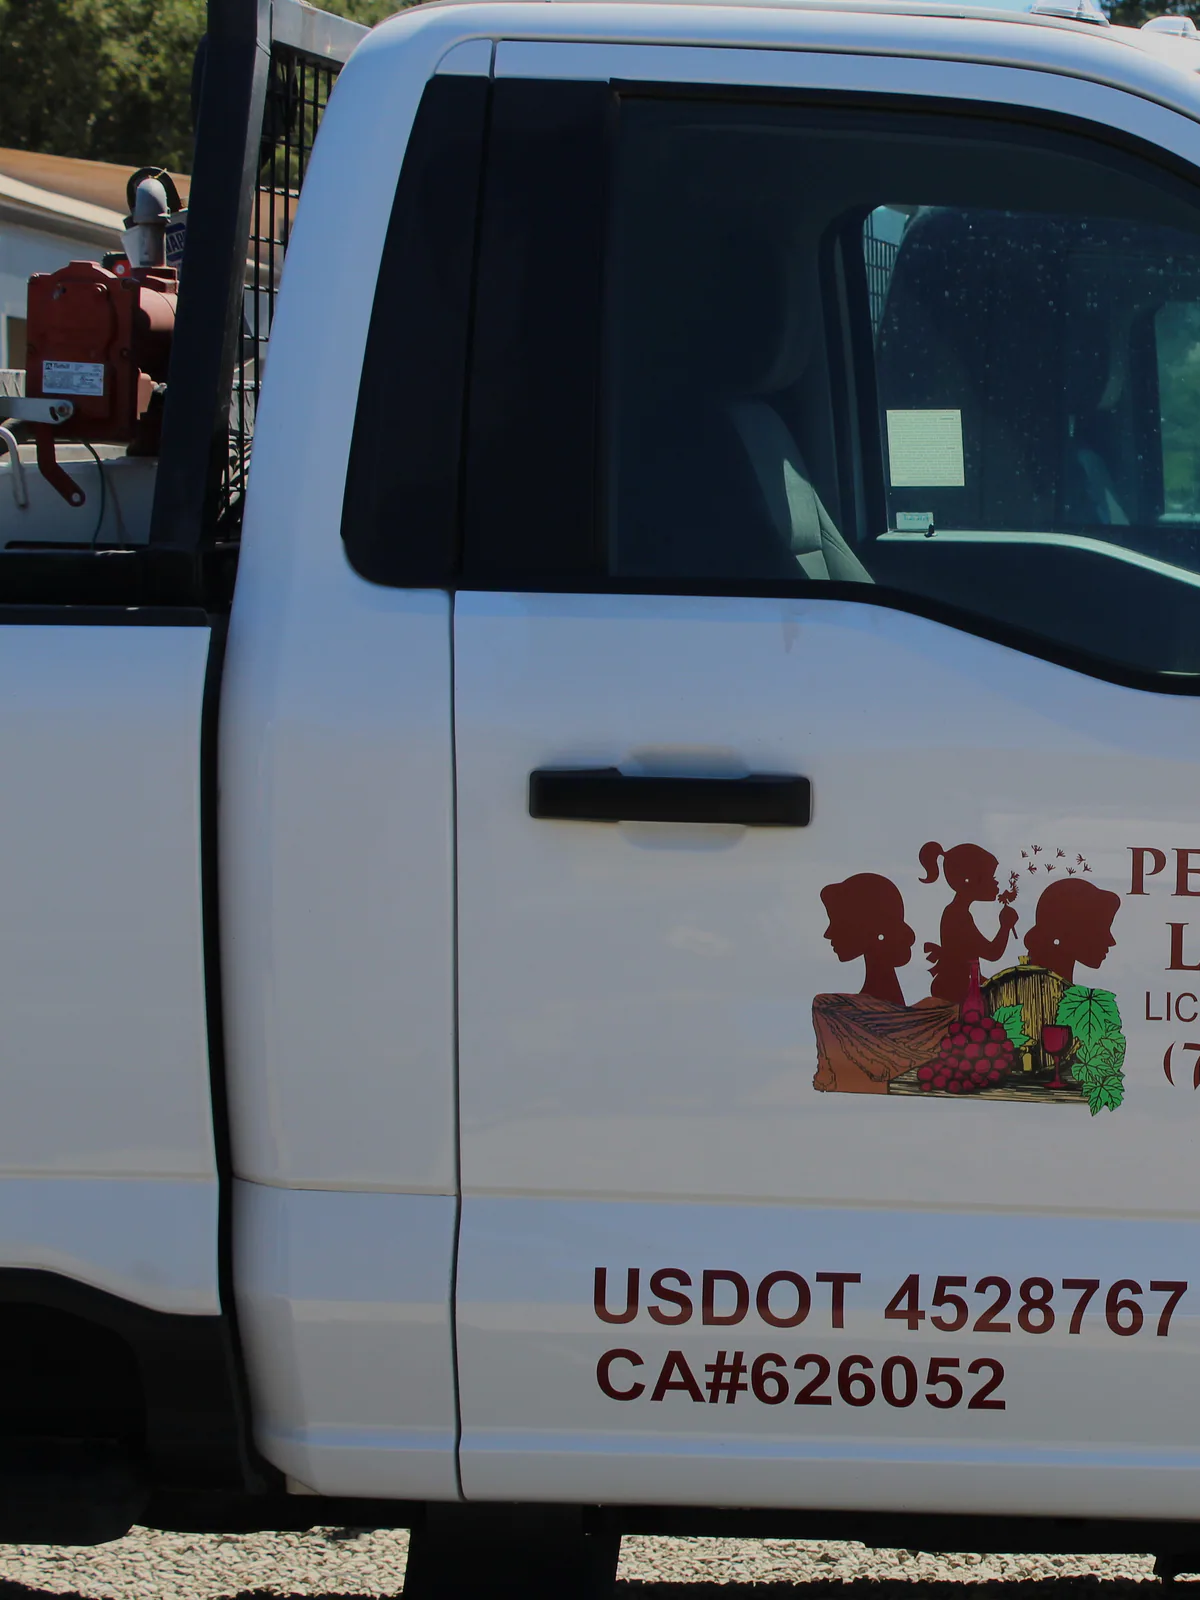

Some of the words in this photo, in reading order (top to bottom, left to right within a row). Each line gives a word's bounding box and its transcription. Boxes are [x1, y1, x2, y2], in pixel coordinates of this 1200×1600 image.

[166, 230, 187, 255] NAP
[594, 1267, 862, 1329] USDOT
[884, 1273, 1189, 1337] 4528767
[596, 1348, 1007, 1410] CA#626052
